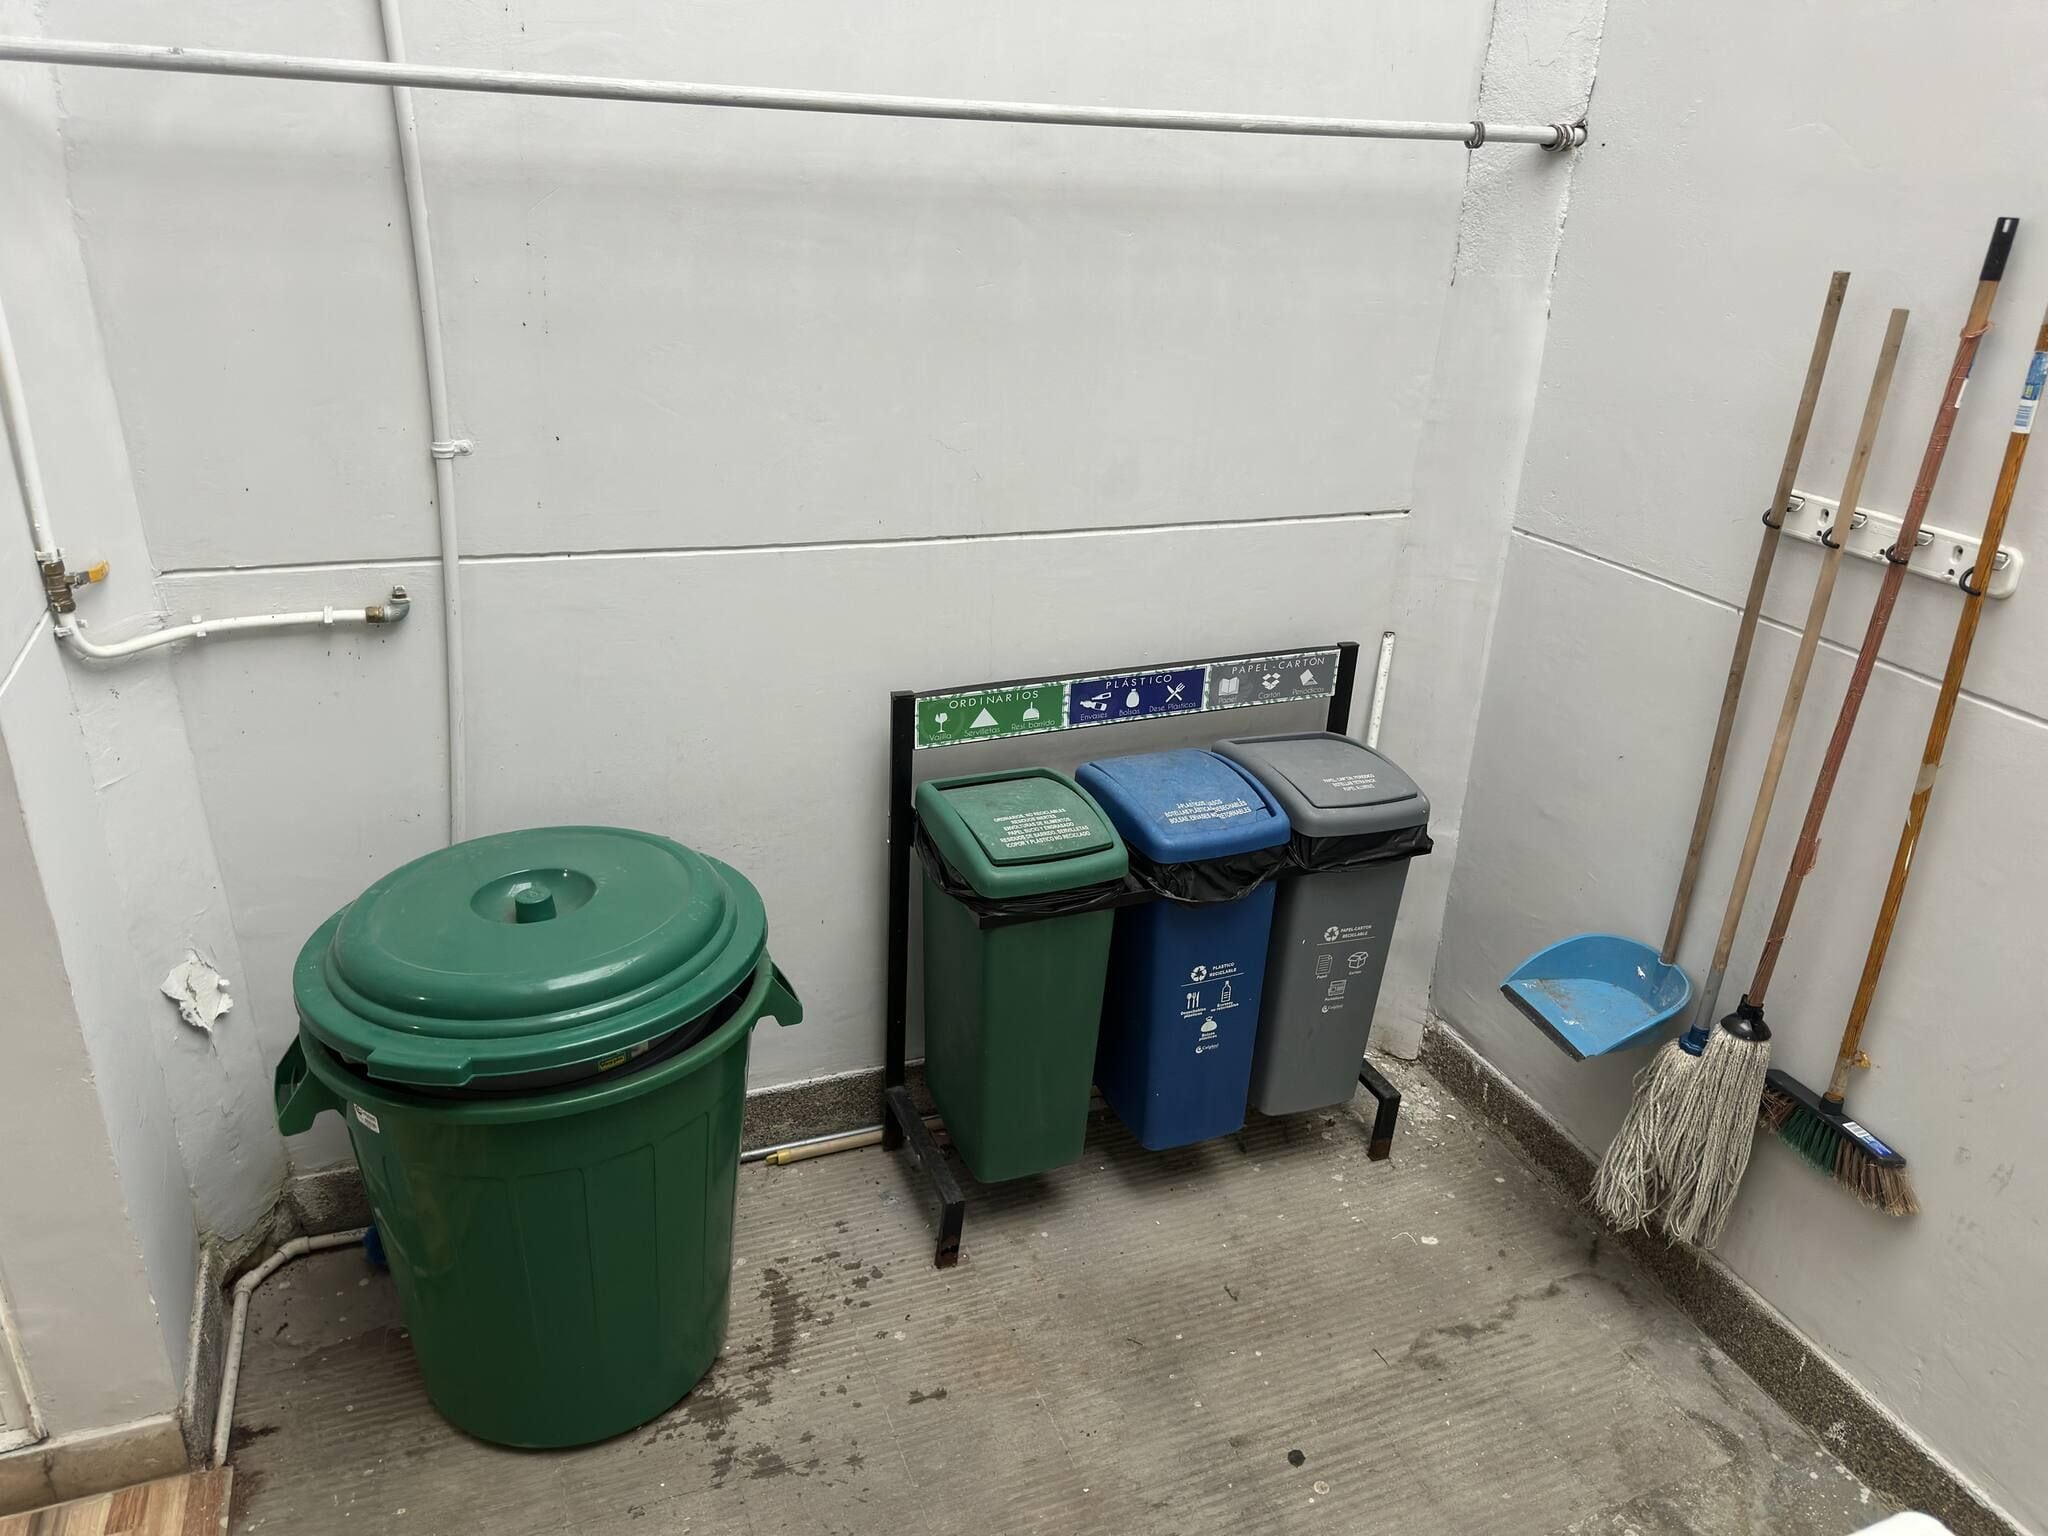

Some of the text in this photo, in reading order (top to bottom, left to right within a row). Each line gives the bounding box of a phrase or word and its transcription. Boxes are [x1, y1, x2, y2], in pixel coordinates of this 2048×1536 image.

[1105, 674, 1172, 689] PLÁSTICO
[949, 690, 1039, 709] ORDINARIOS
[1080, 712, 1108, 721] Envases
[964, 726, 1000, 738] Servilletas
